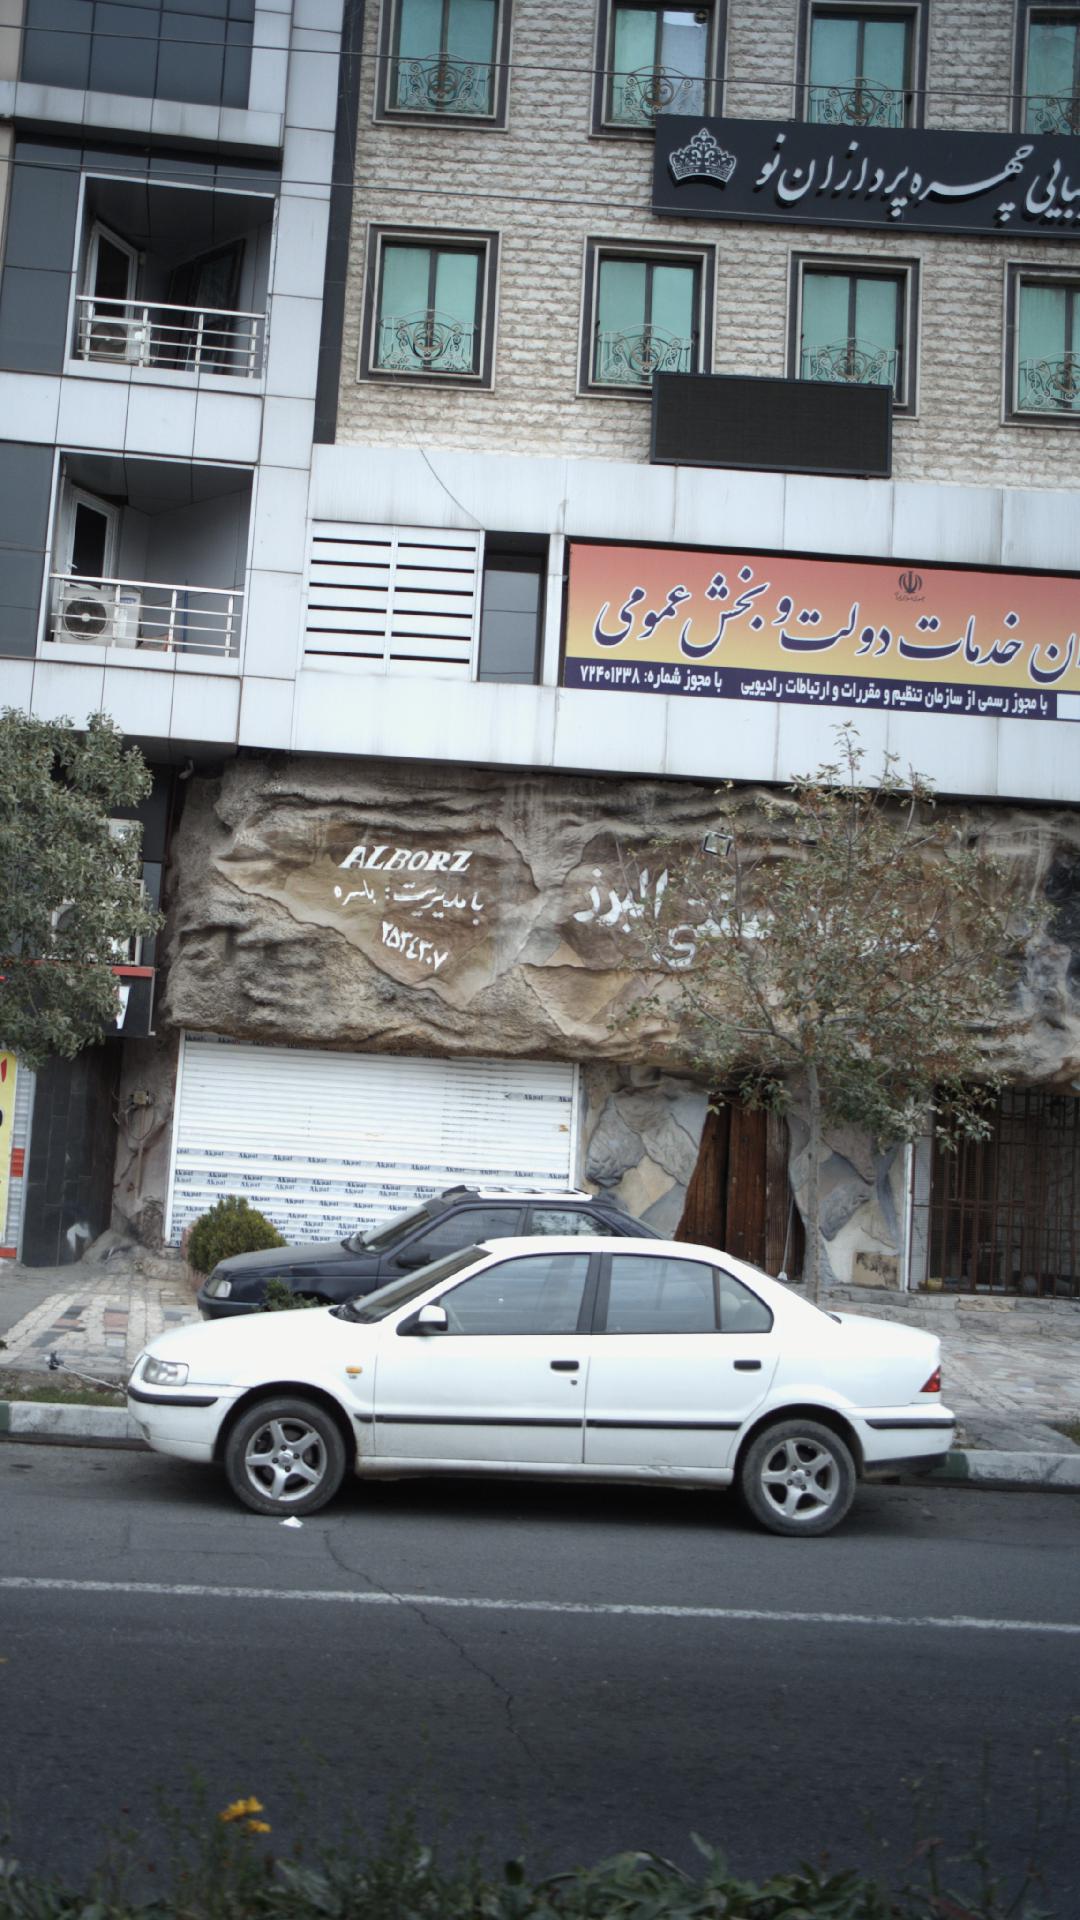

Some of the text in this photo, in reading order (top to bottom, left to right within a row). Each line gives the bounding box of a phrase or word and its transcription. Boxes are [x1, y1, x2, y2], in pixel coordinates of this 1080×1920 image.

[756, 133, 787, 186] نو
[909, 144, 1034, 222] چهره
[594, 585, 692, 647] عمومی
[679, 566, 771, 658] بخش
[772, 596, 794, 624] و
[779, 602, 892, 656] دولت
[898, 612, 1025, 667] خدمات
[580, 665, 723, 693] با مجوز شماره: ۷۲۴۰۱۲۳۸
[740, 677, 1048, 715] با مجوز رسمی از سازمان تنظیم و مقررات و ارتباطات رادیویی
[338, 845, 473, 872] ALBORZ
[470, 891, 484, 926] با
[573, 867, 669, 934] البرز
